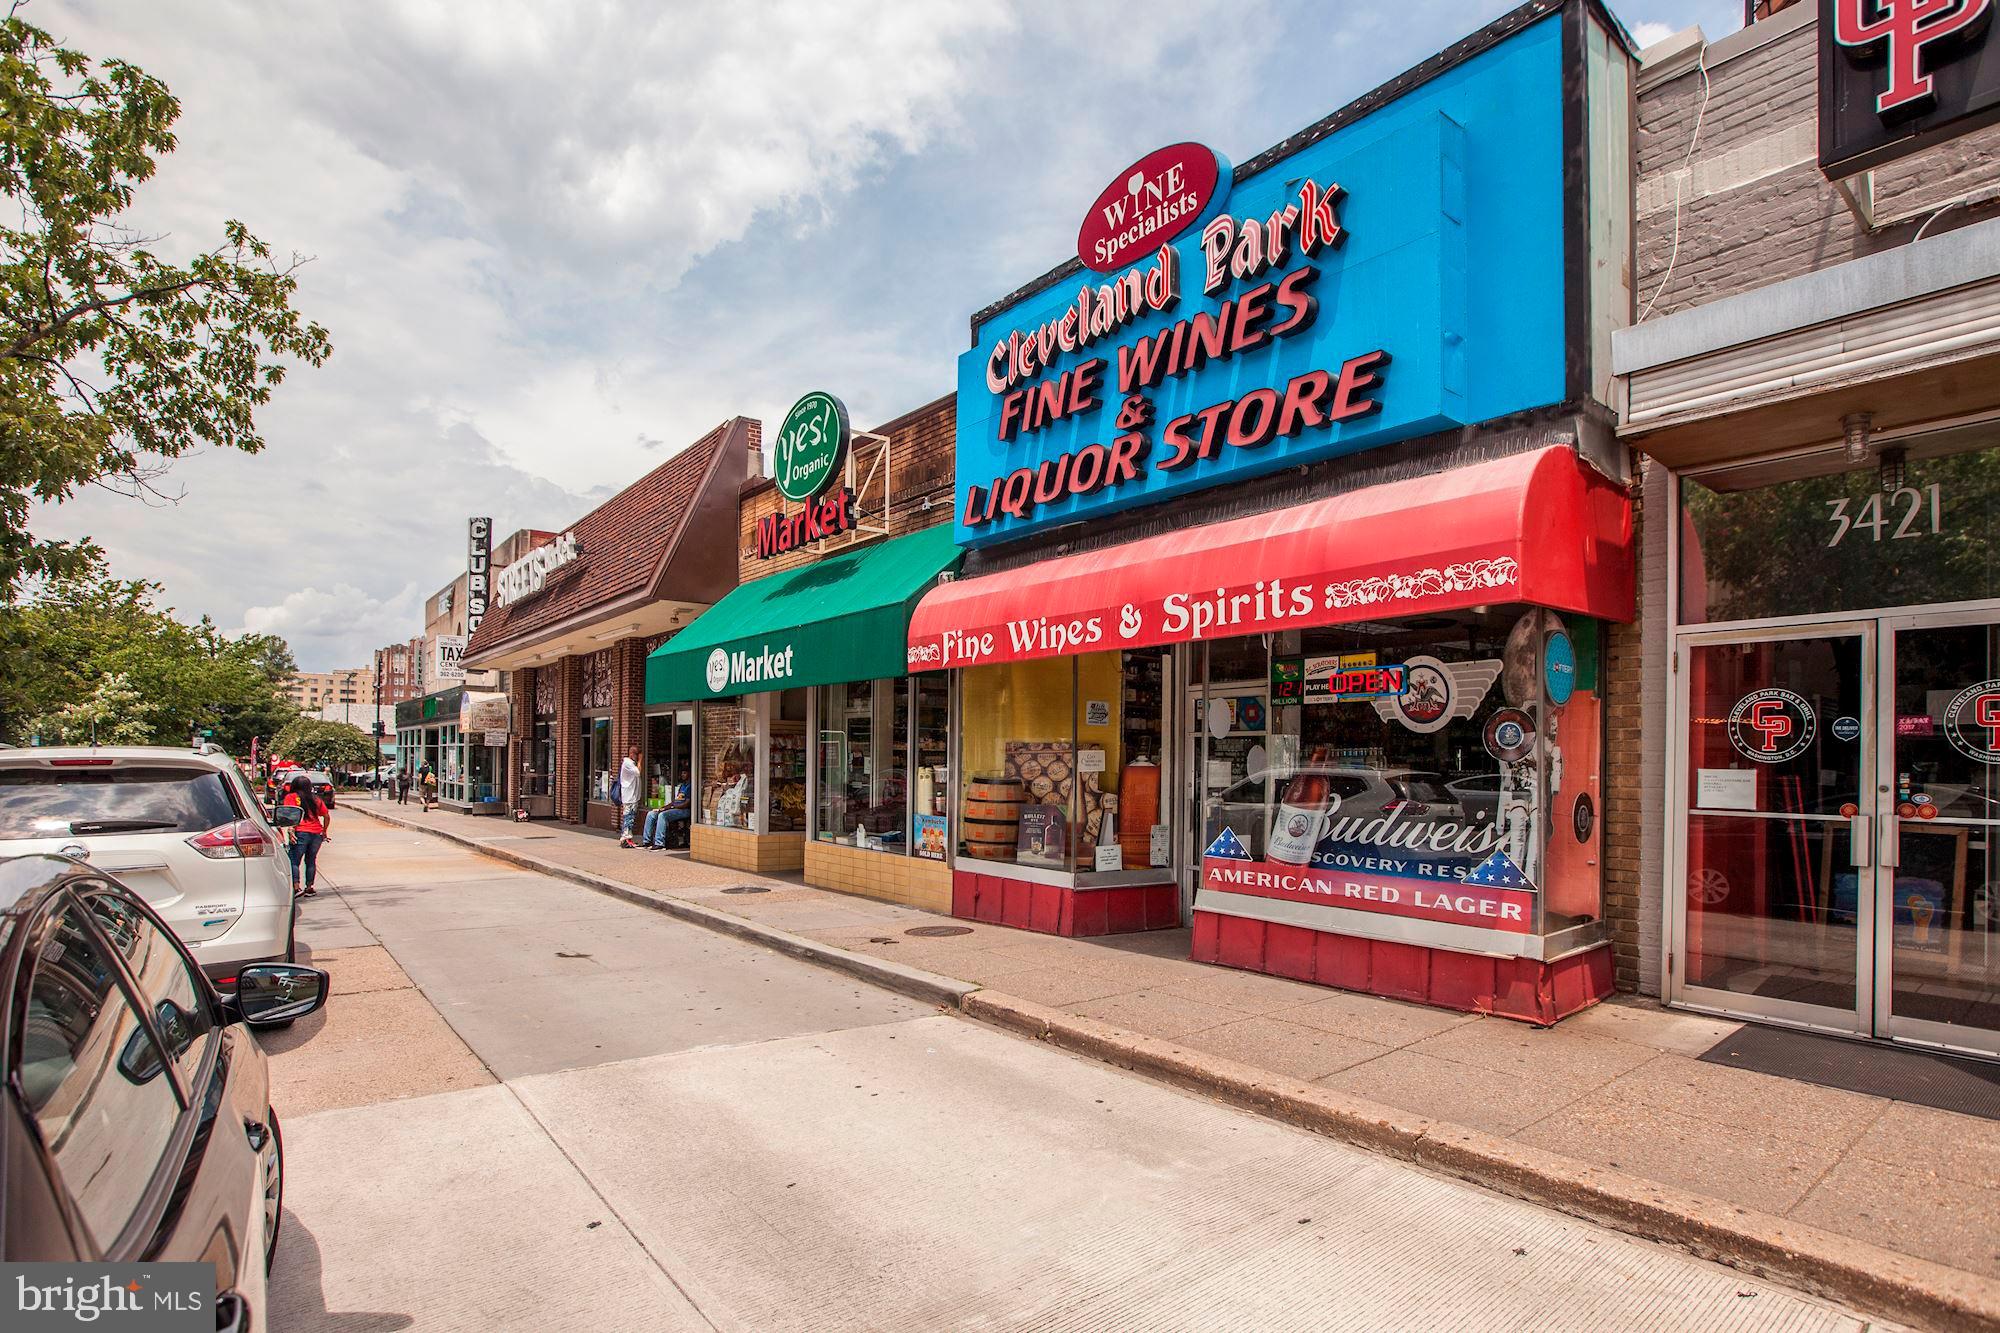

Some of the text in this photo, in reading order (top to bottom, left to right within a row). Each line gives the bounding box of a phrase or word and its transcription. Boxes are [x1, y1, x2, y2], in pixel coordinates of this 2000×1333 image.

[1103, 162, 1185, 230] WINE
[1095, 191, 1198, 264] Specialists
[986, 178, 1347, 395] Cleveland Park
[998, 265, 1319, 441] FINE WINES
[1115, 394, 1155, 432] &
[963, 350, 1390, 527] LIQUOR STORE
[792, 452, 829, 481] Organic
[757, 487, 851, 560] Market
[1825, 482, 1940, 548] 3421
[942, 578, 1314, 667] Fine Wines & Spirits
[440, 647, 463, 661] TAX
[730, 644, 794, 684] Market
[1272, 697, 1298, 705] MILLION
[1328, 670, 1401, 694] OPEN
[1731, 694, 1759, 722] CLEVELAND
[1780, 691, 1795, 701] BAR
[1799, 703, 1813, 720] GRILL
[1948, 686, 1983, 718] CLEVELAND
[1752, 701, 1791, 751] CP
[931, 851, 944, 860] HERE
[1208, 867, 1523, 921] AMERICAN RED LAGER
